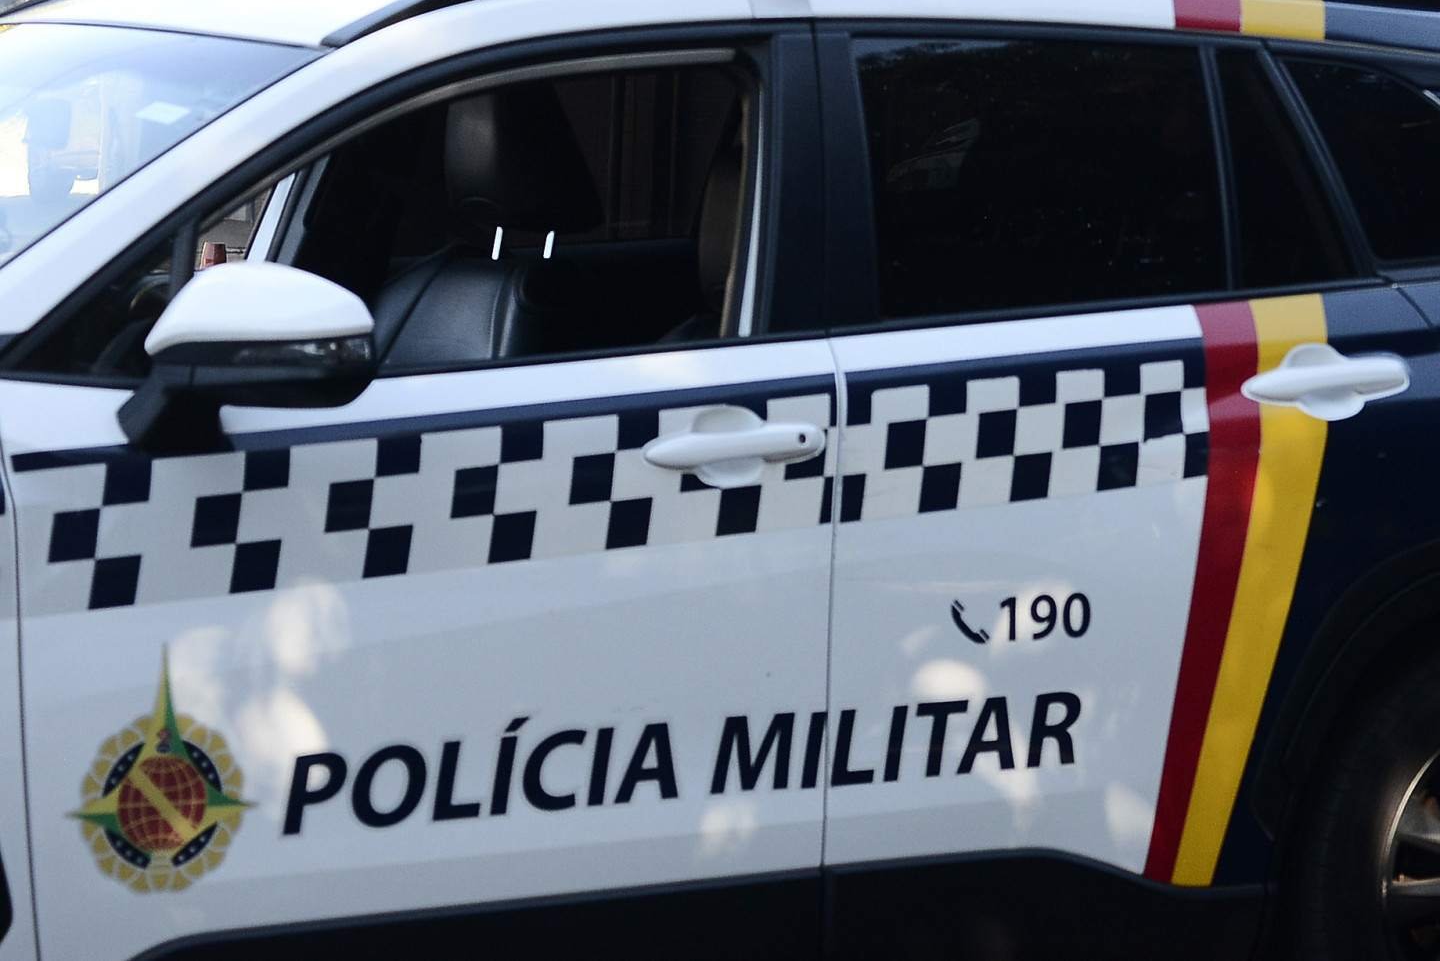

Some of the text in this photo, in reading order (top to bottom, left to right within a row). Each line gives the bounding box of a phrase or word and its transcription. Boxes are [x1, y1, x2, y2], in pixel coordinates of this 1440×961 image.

[1000, 592, 1091, 641] 190
[282, 690, 1082, 837] POLÍCIA MILITAR
